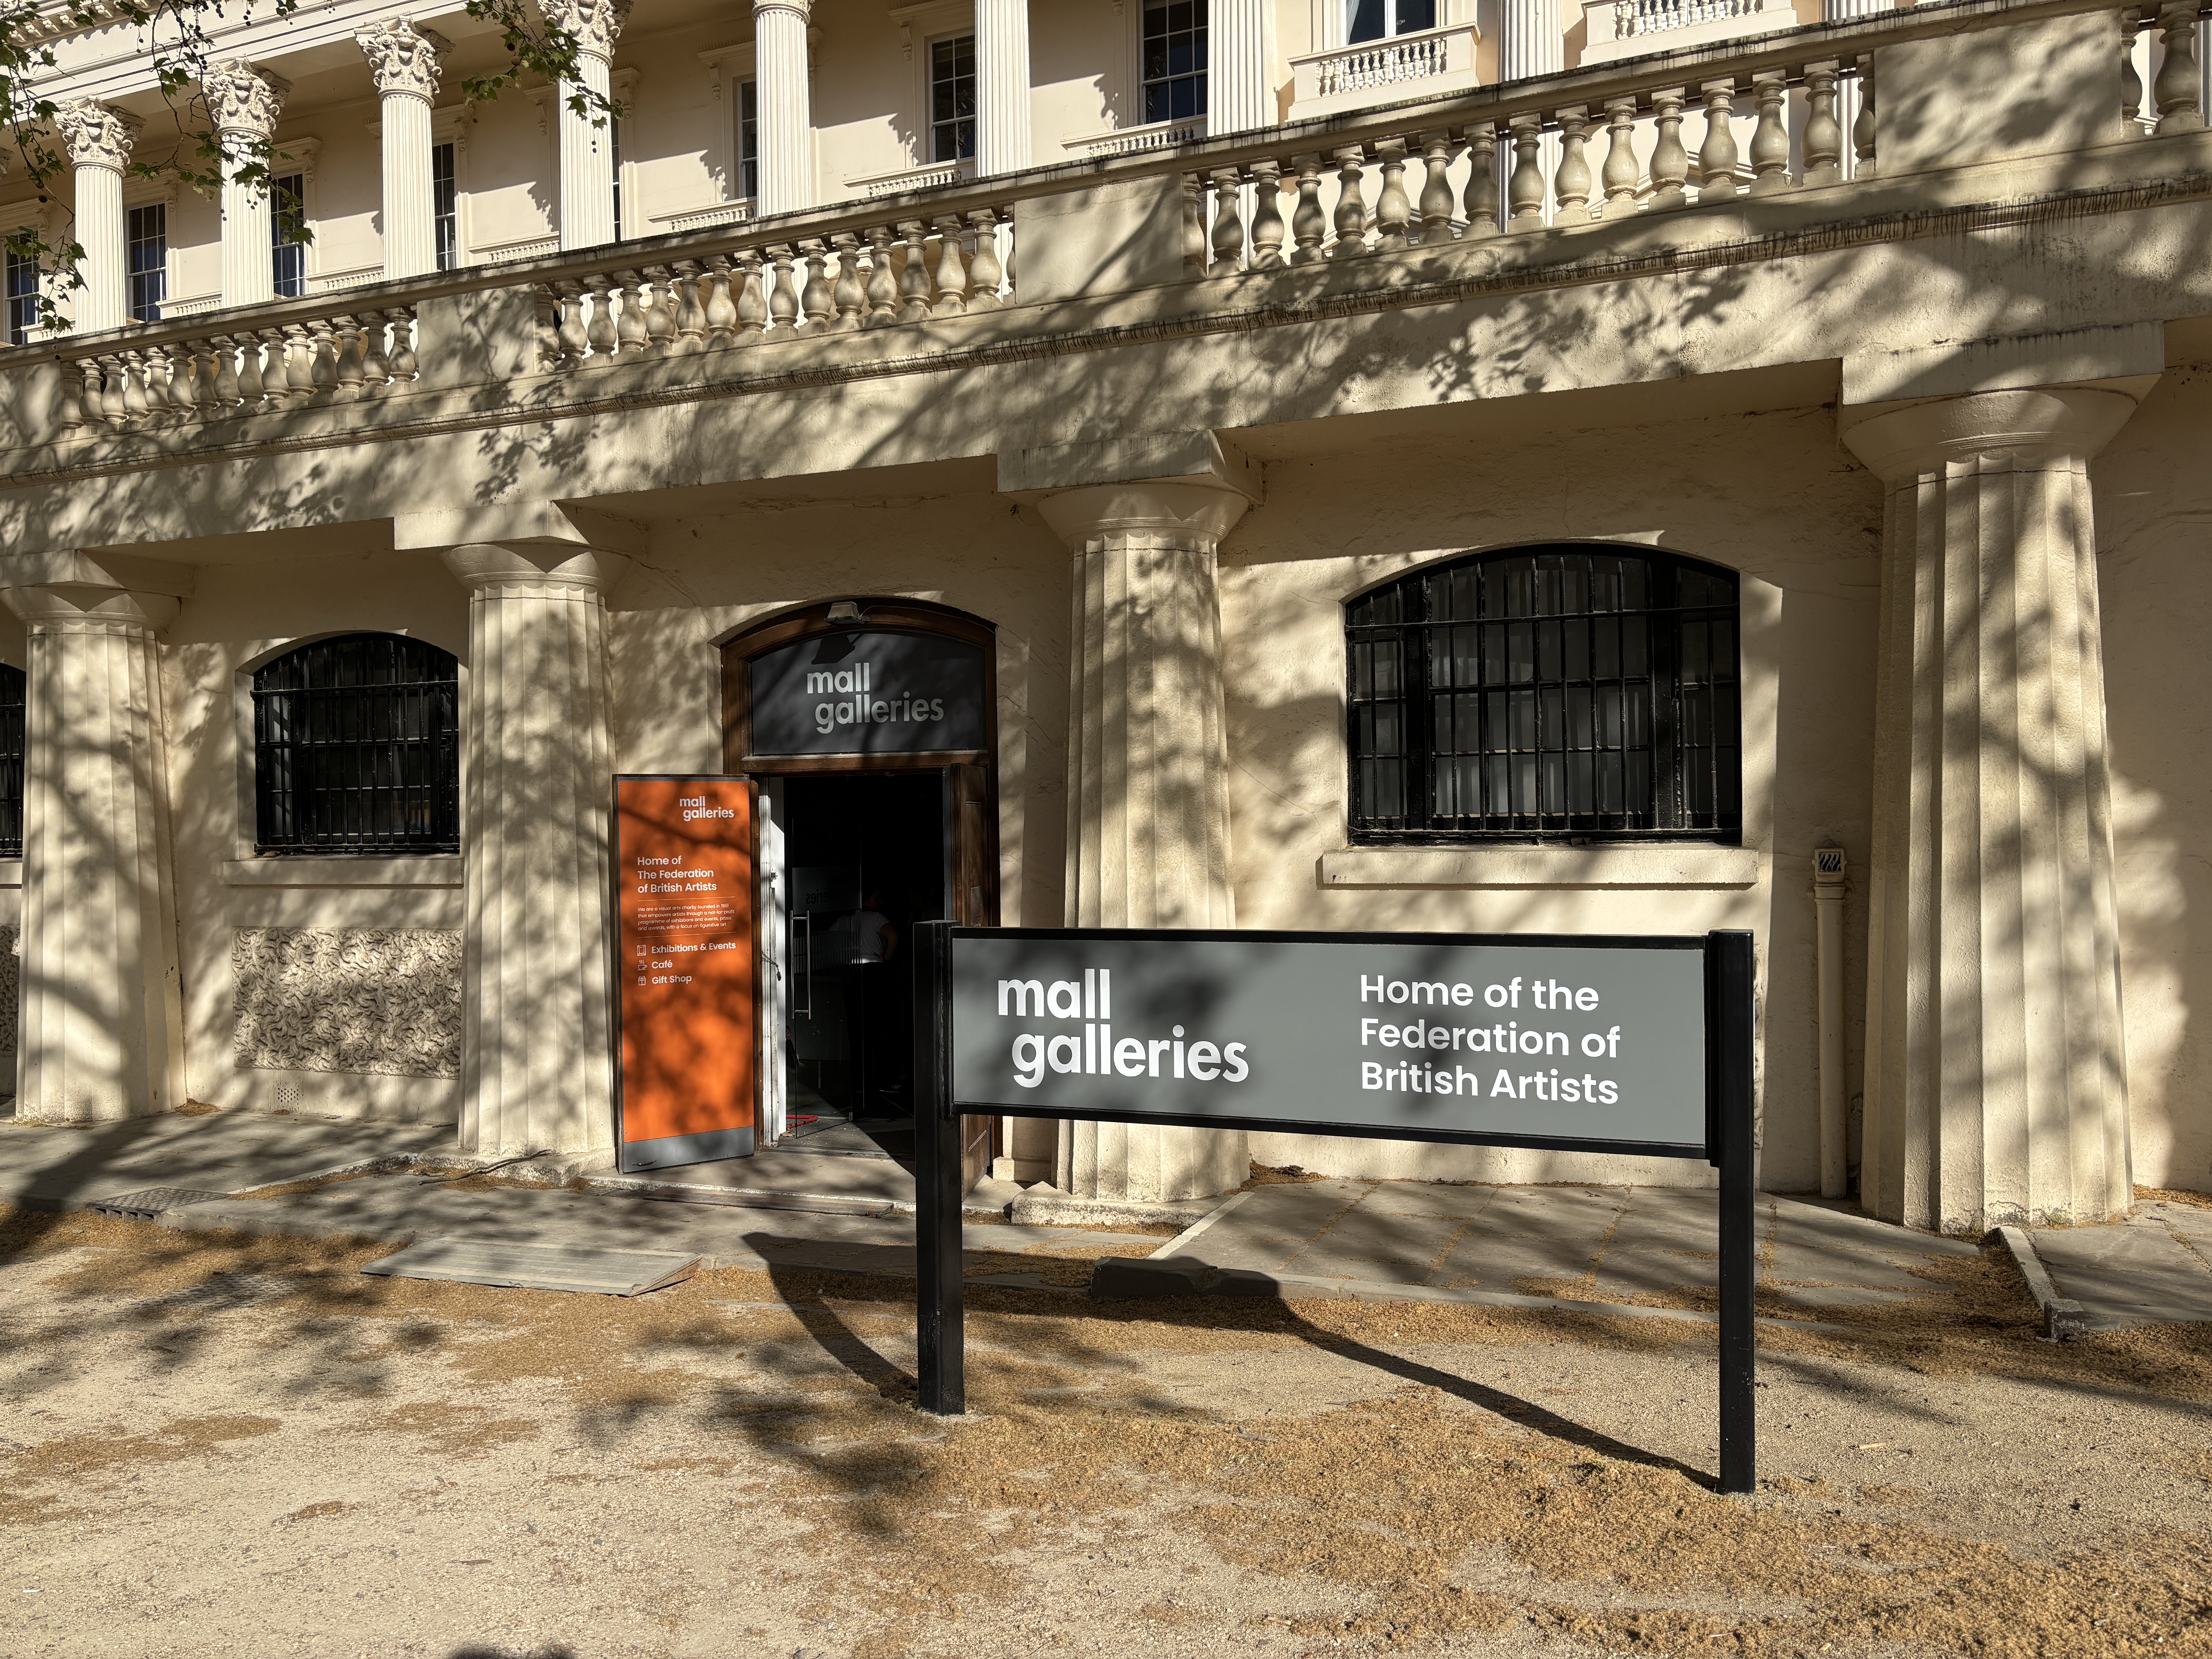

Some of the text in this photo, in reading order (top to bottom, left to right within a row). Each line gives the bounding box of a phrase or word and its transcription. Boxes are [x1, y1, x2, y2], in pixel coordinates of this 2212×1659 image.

[807, 663, 870, 694] mall
[815, 691, 944, 734] galleries
[680, 796, 705, 807] mall
[683, 807, 734, 821] galleries
[637, 855, 682, 865] Home of
[637, 868, 714, 879] The Federation
[637, 881, 717, 893] of British Artists
[651, 944, 698, 953] Exhibitions
[709, 942, 736, 950] Events
[651, 960, 673, 969] Café
[652, 975, 692, 984] Gift Shop
[998, 969, 1111, 1019] mall
[1360, 974, 1599, 1012] Home of the
[1360, 1017, 1620, 1058] Federation of
[1012, 1023, 1249, 1088] galleries
[1361, 1060, 1619, 1105] British Artists
